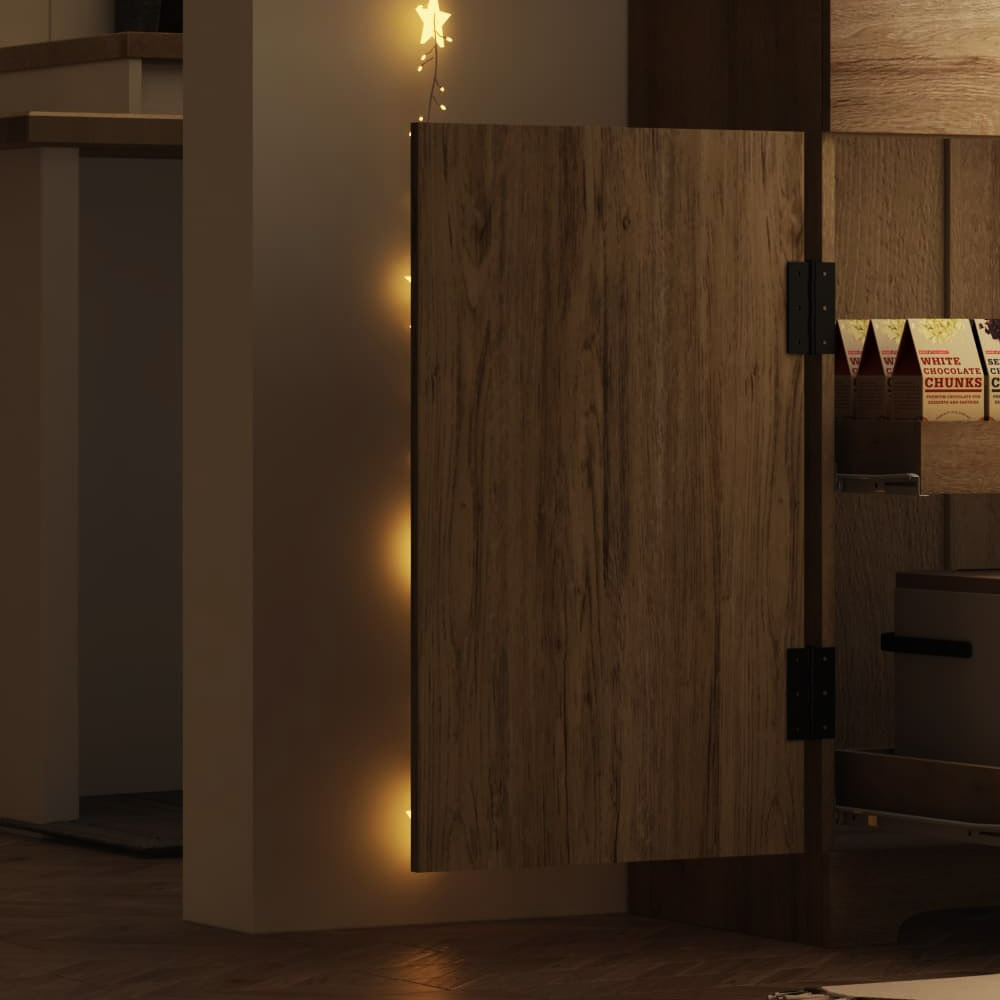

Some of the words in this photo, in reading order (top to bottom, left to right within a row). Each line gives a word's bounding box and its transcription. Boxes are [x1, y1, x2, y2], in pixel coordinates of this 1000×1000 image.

[920, 357, 961, 367] WHITE
[924, 367, 982, 376] CHOCOLATE
[925, 377, 983, 389] CHUNKS
